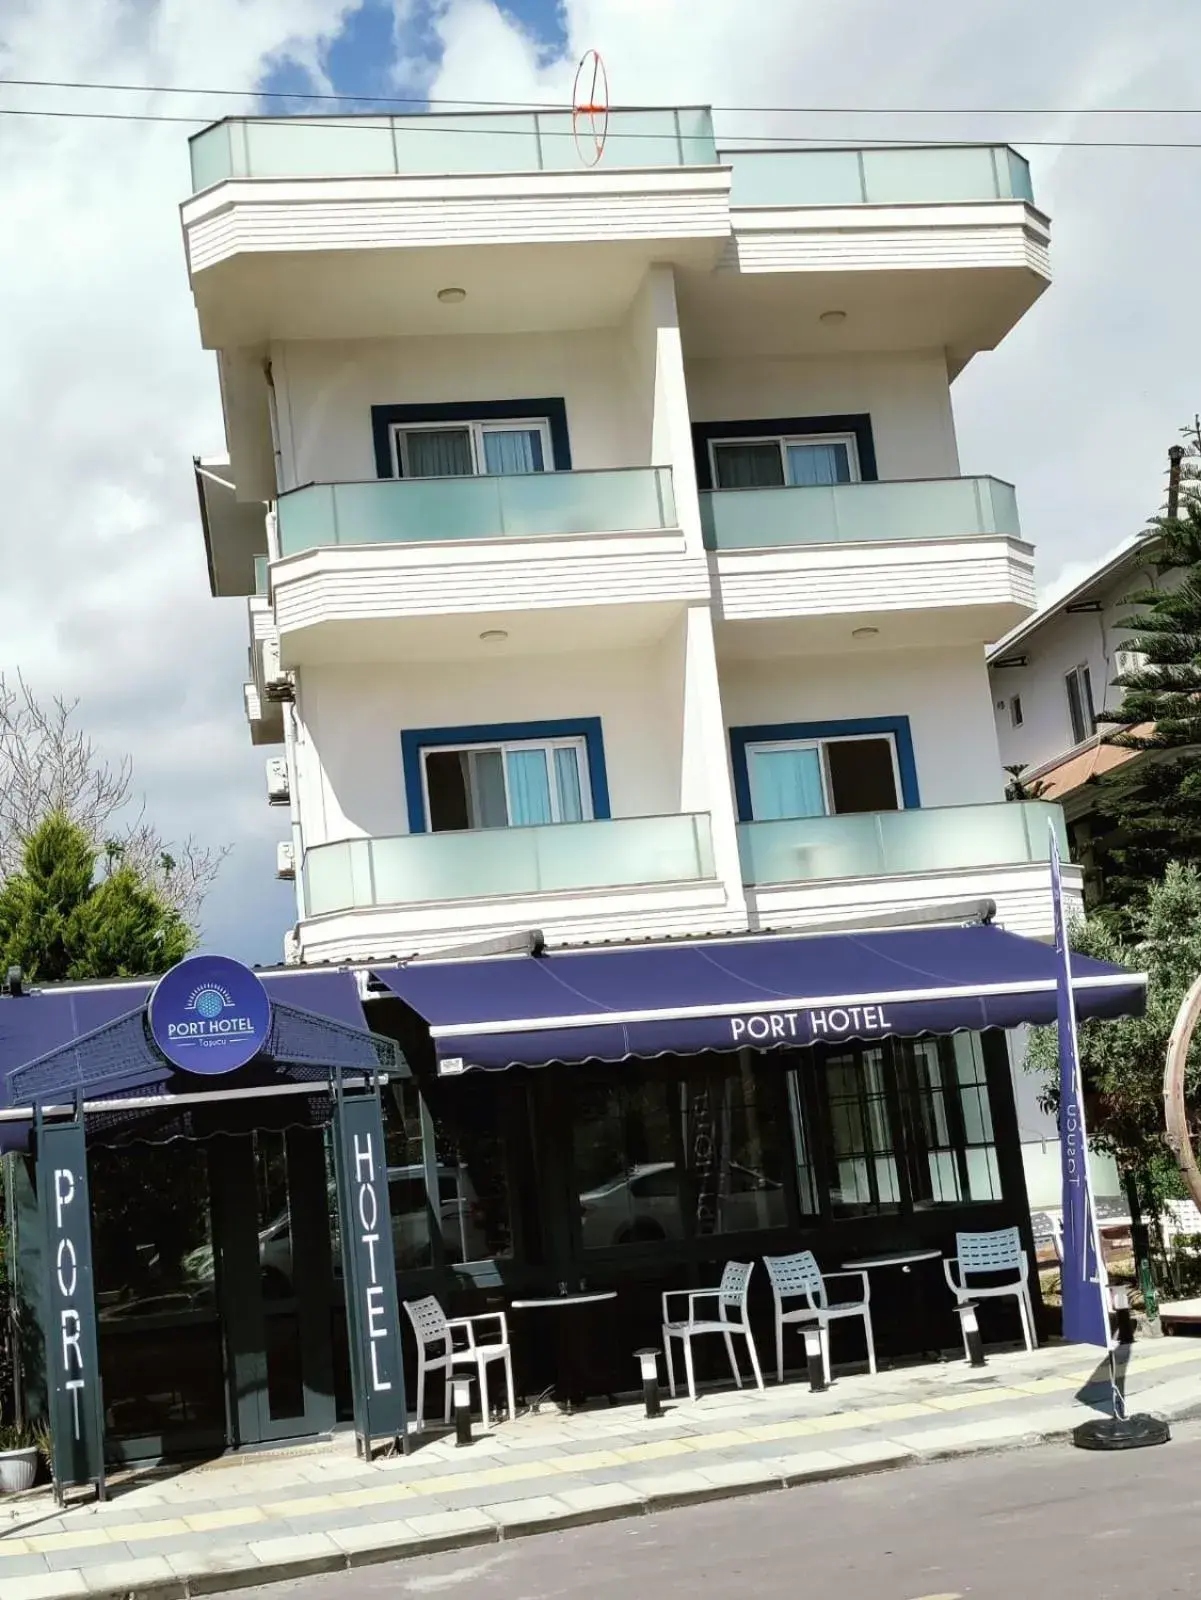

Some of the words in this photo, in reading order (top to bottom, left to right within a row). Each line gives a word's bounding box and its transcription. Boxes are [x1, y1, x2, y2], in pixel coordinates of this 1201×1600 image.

[168, 1021, 205, 1036] PORT
[210, 1018, 254, 1033] HOTEL
[730, 1012, 798, 1042] PORT
[809, 1005, 892, 1034] HOTEL
[53, 1169, 85, 1440] PORT
[354, 1134, 391, 1391] HOTEL
